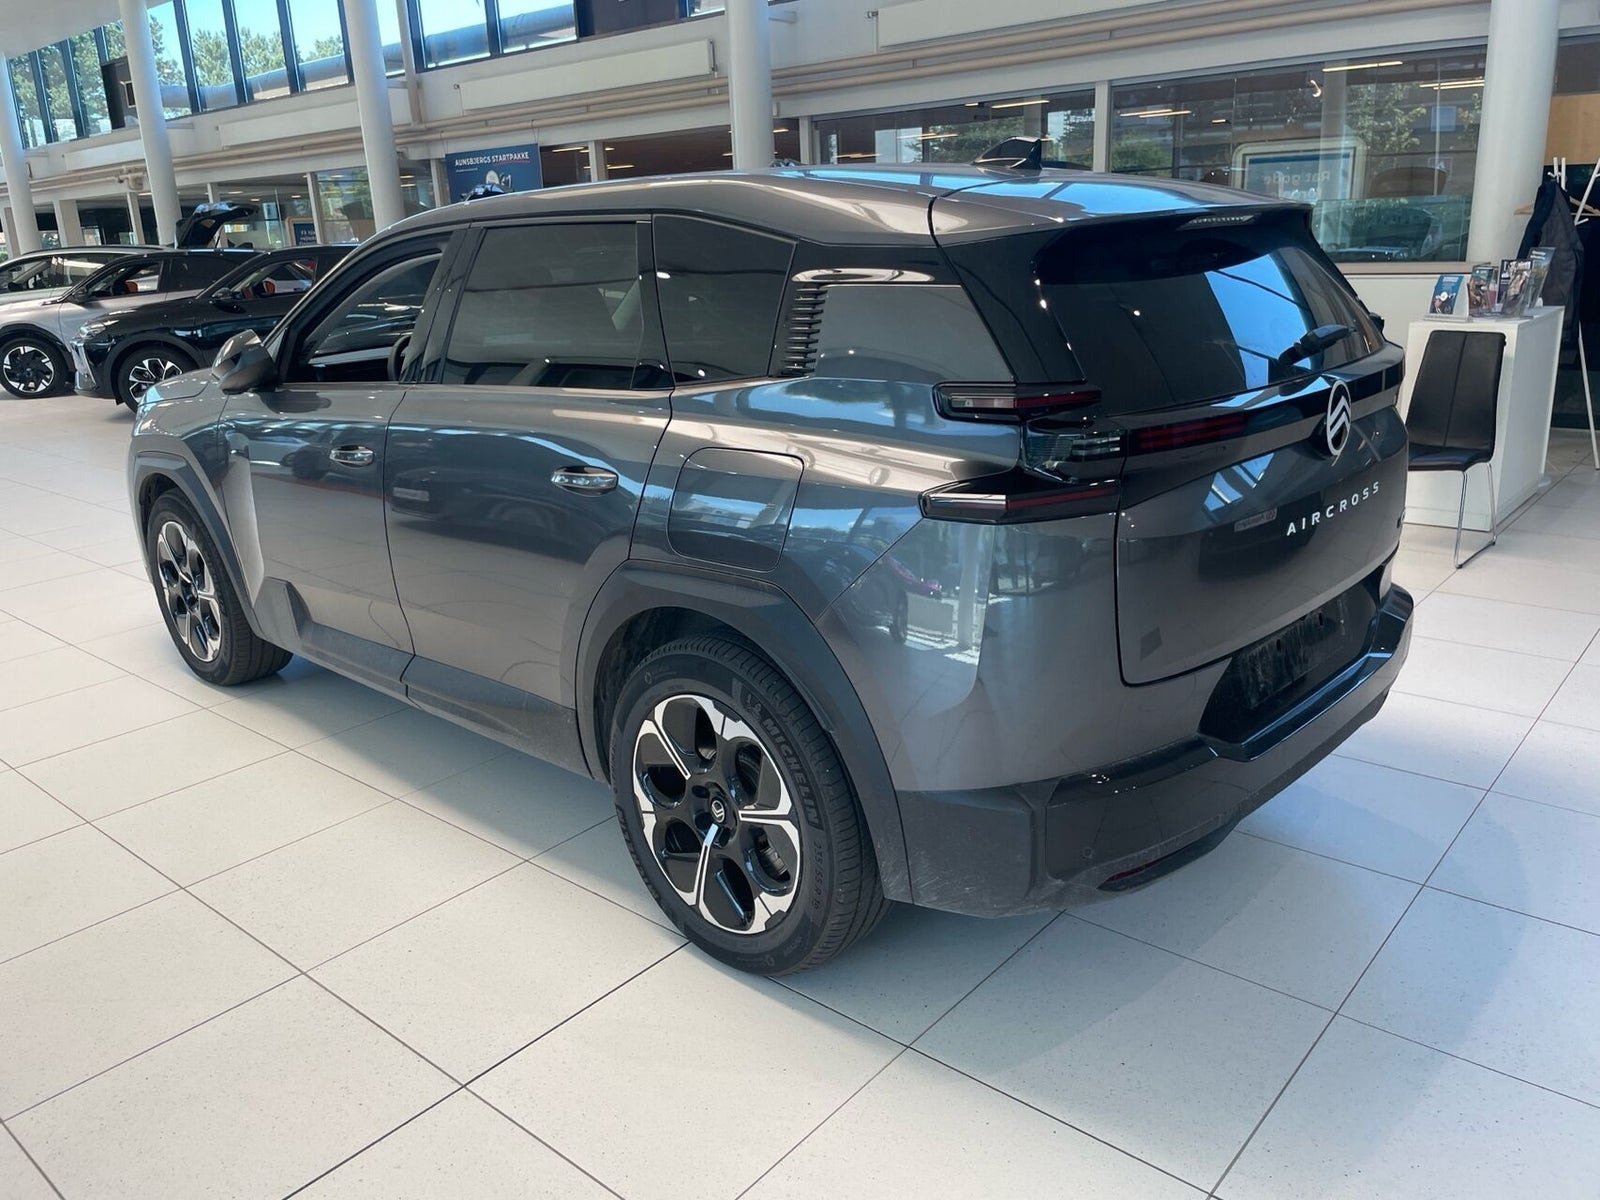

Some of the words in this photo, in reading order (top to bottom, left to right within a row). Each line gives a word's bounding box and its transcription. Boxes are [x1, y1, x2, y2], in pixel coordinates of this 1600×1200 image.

[492, 152, 529, 162] STARTPAKKE
[1286, 481, 1380, 536] AIRCROSS
[762, 718, 820, 824] MICHELIN
